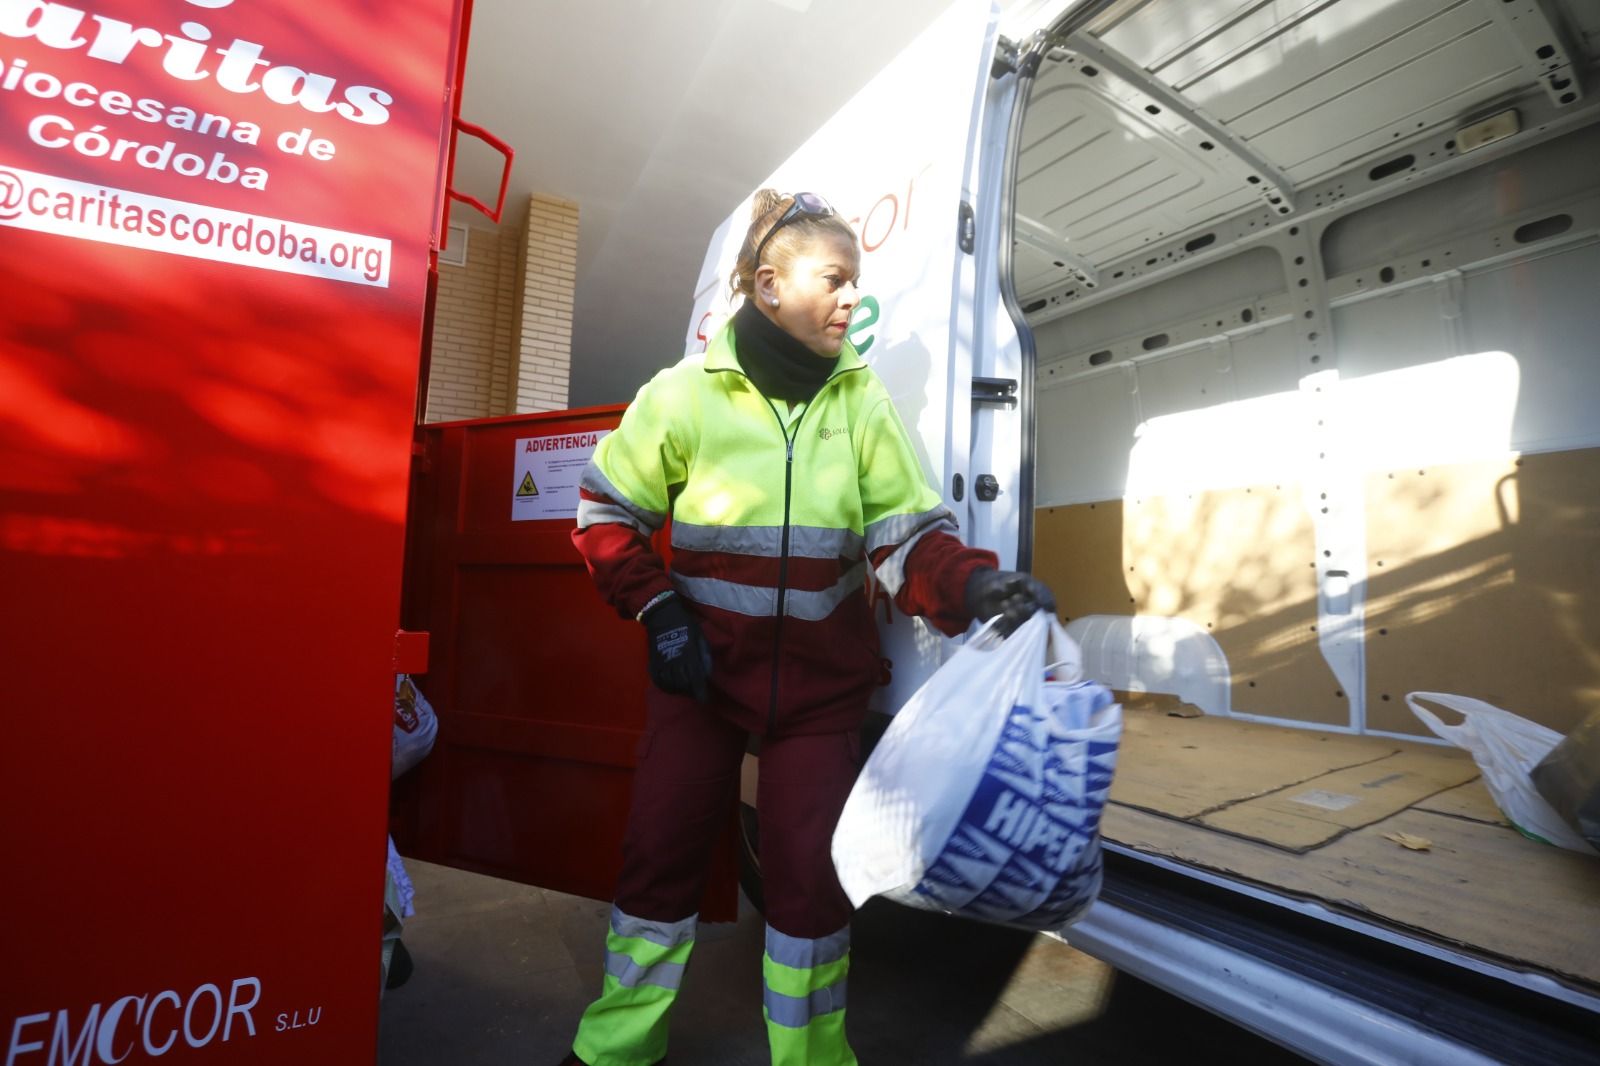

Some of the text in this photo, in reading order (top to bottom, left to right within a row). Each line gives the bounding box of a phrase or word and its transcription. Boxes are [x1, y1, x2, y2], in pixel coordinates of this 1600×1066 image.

[0, 58, 336, 161] iocesana de
[28, 115, 269, 190] Córdoba
[526, 434, 598, 453] ADVERTENCIA
[275, 1006, 322, 1032] S.L.U
